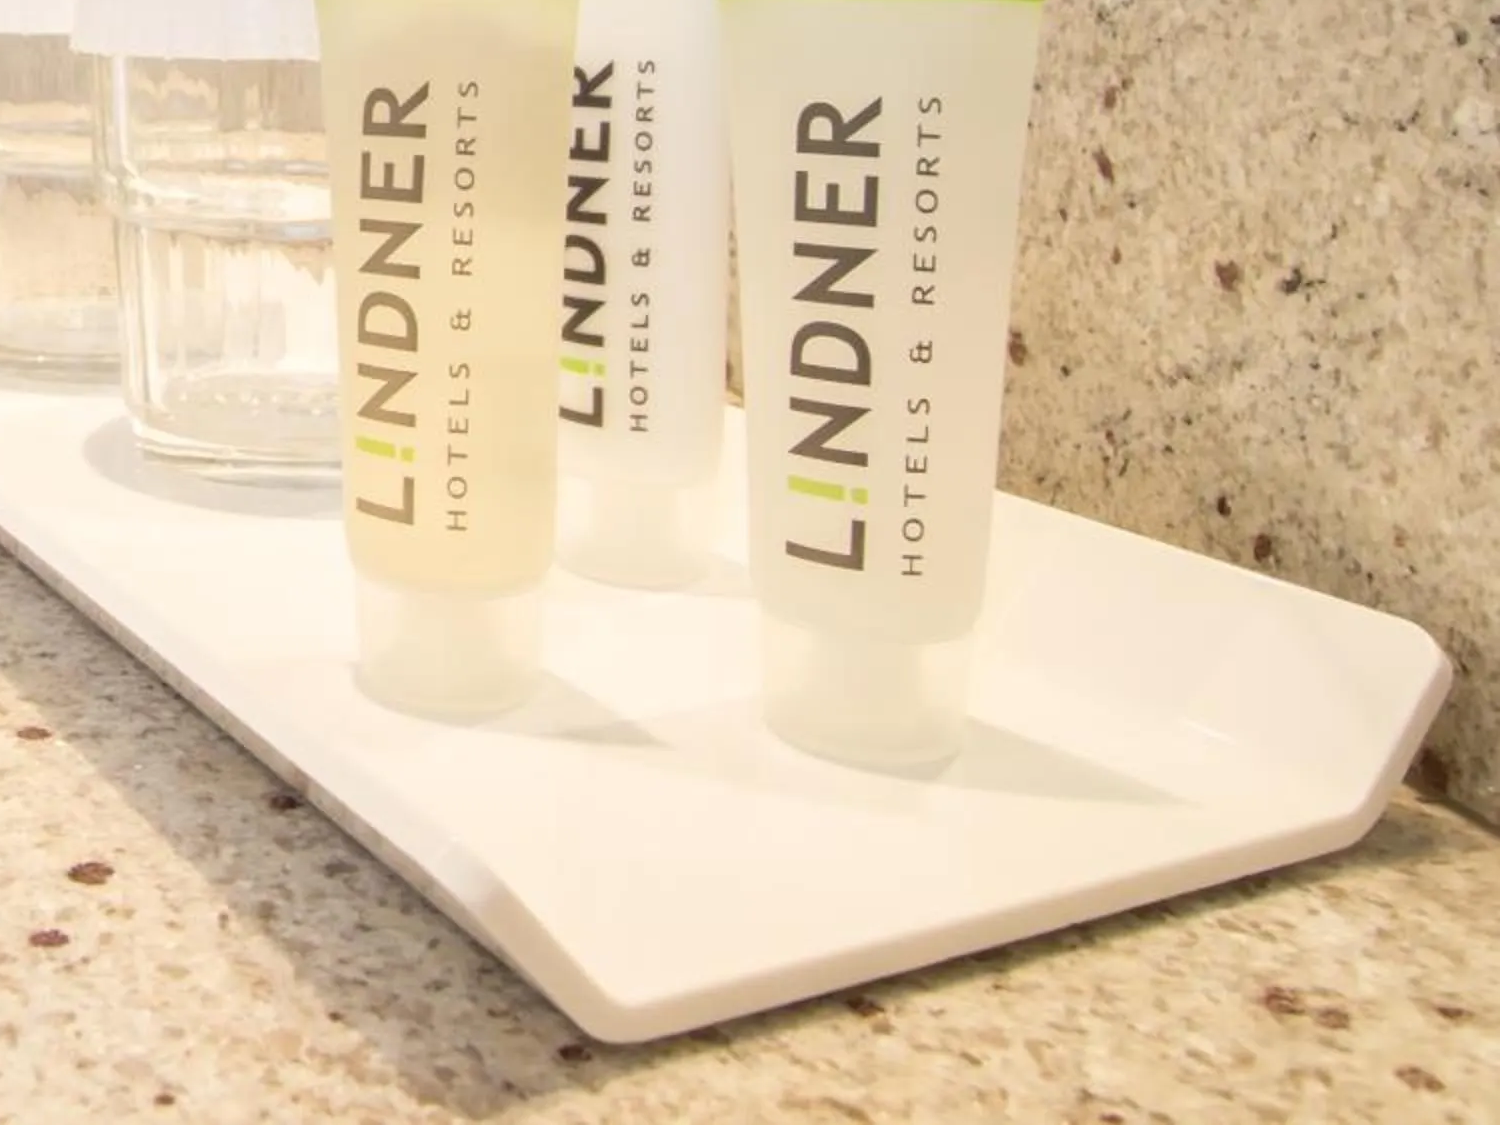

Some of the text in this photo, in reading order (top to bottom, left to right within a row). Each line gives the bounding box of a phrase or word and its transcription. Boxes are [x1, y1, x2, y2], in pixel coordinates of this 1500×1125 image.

[446, 79, 479, 532] HOTELS & RESORTS
[628, 59, 656, 433] HOTELS & RESORTS
[901, 95, 942, 576] HOTELS & RESORTS
